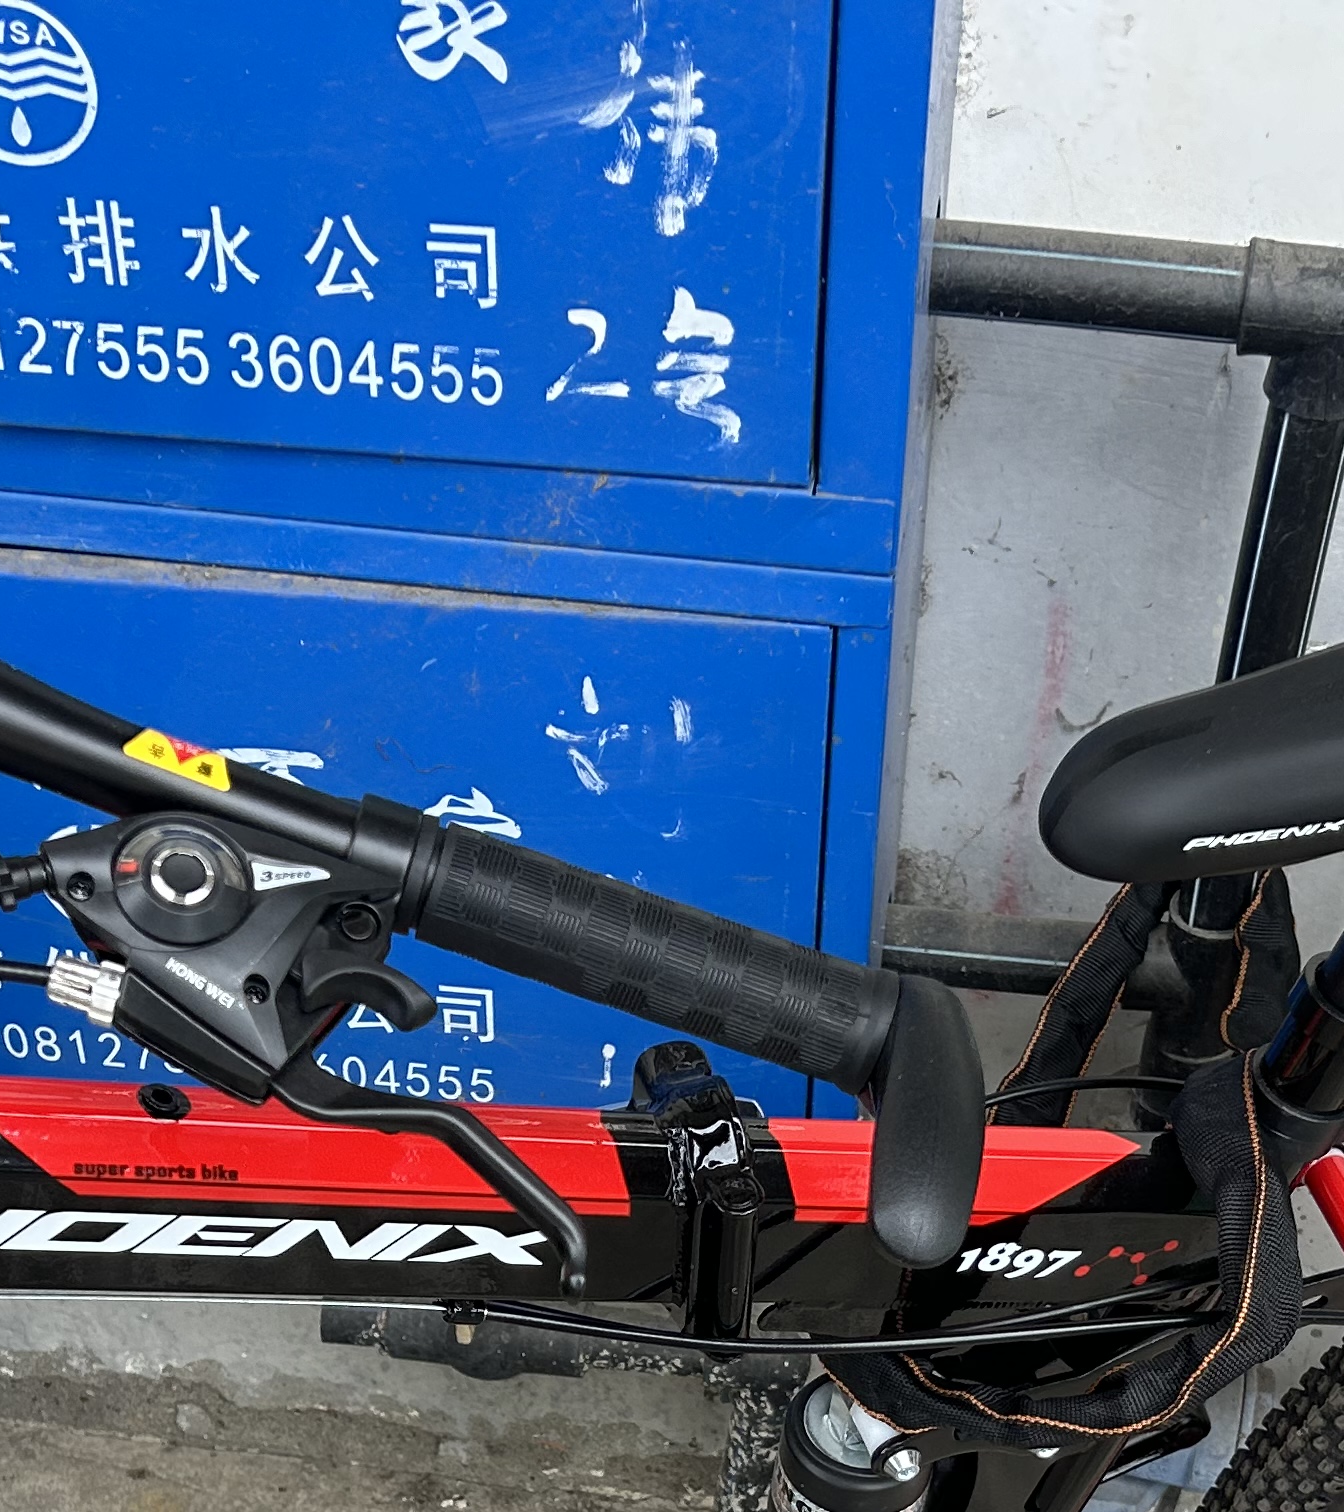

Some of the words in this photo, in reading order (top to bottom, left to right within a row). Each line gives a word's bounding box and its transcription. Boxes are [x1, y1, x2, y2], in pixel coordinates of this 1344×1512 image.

[229, 332, 503, 406] 3604555
[164, 956, 208, 991] HONG
[204, 977, 237, 1010] WEI
[73, 1161, 128, 1179] super
[134, 1162, 197, 1182] sports
[201, 1162, 239, 1182] bike
[956, 1242, 1082, 1279] 1897
